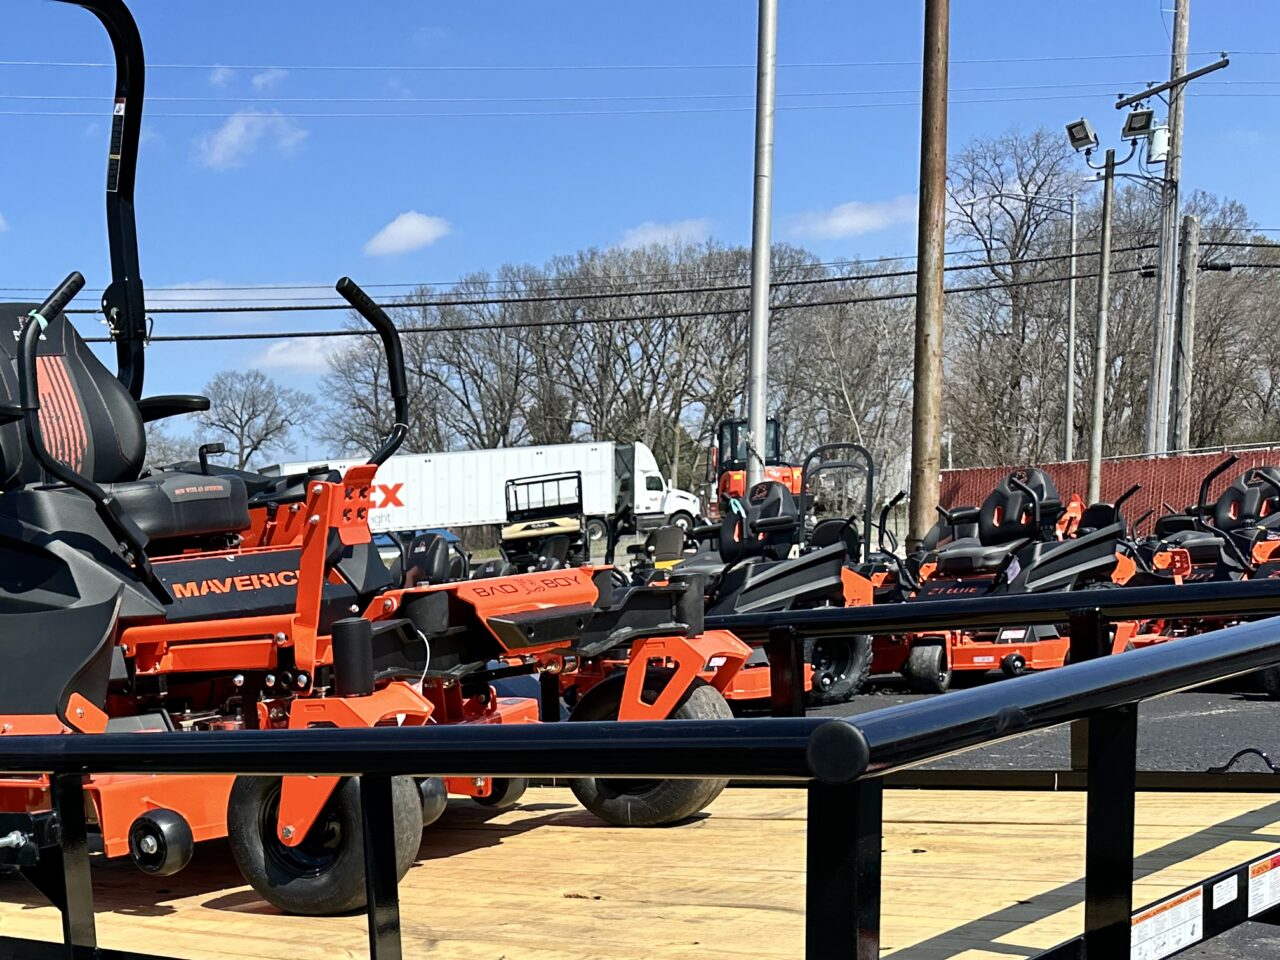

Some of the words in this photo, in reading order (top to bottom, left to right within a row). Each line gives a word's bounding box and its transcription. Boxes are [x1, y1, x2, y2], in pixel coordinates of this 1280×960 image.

[172, 570, 300, 598] MAVERIC
[472, 584, 518, 597] BAD
[541, 576, 581, 588] BOY
